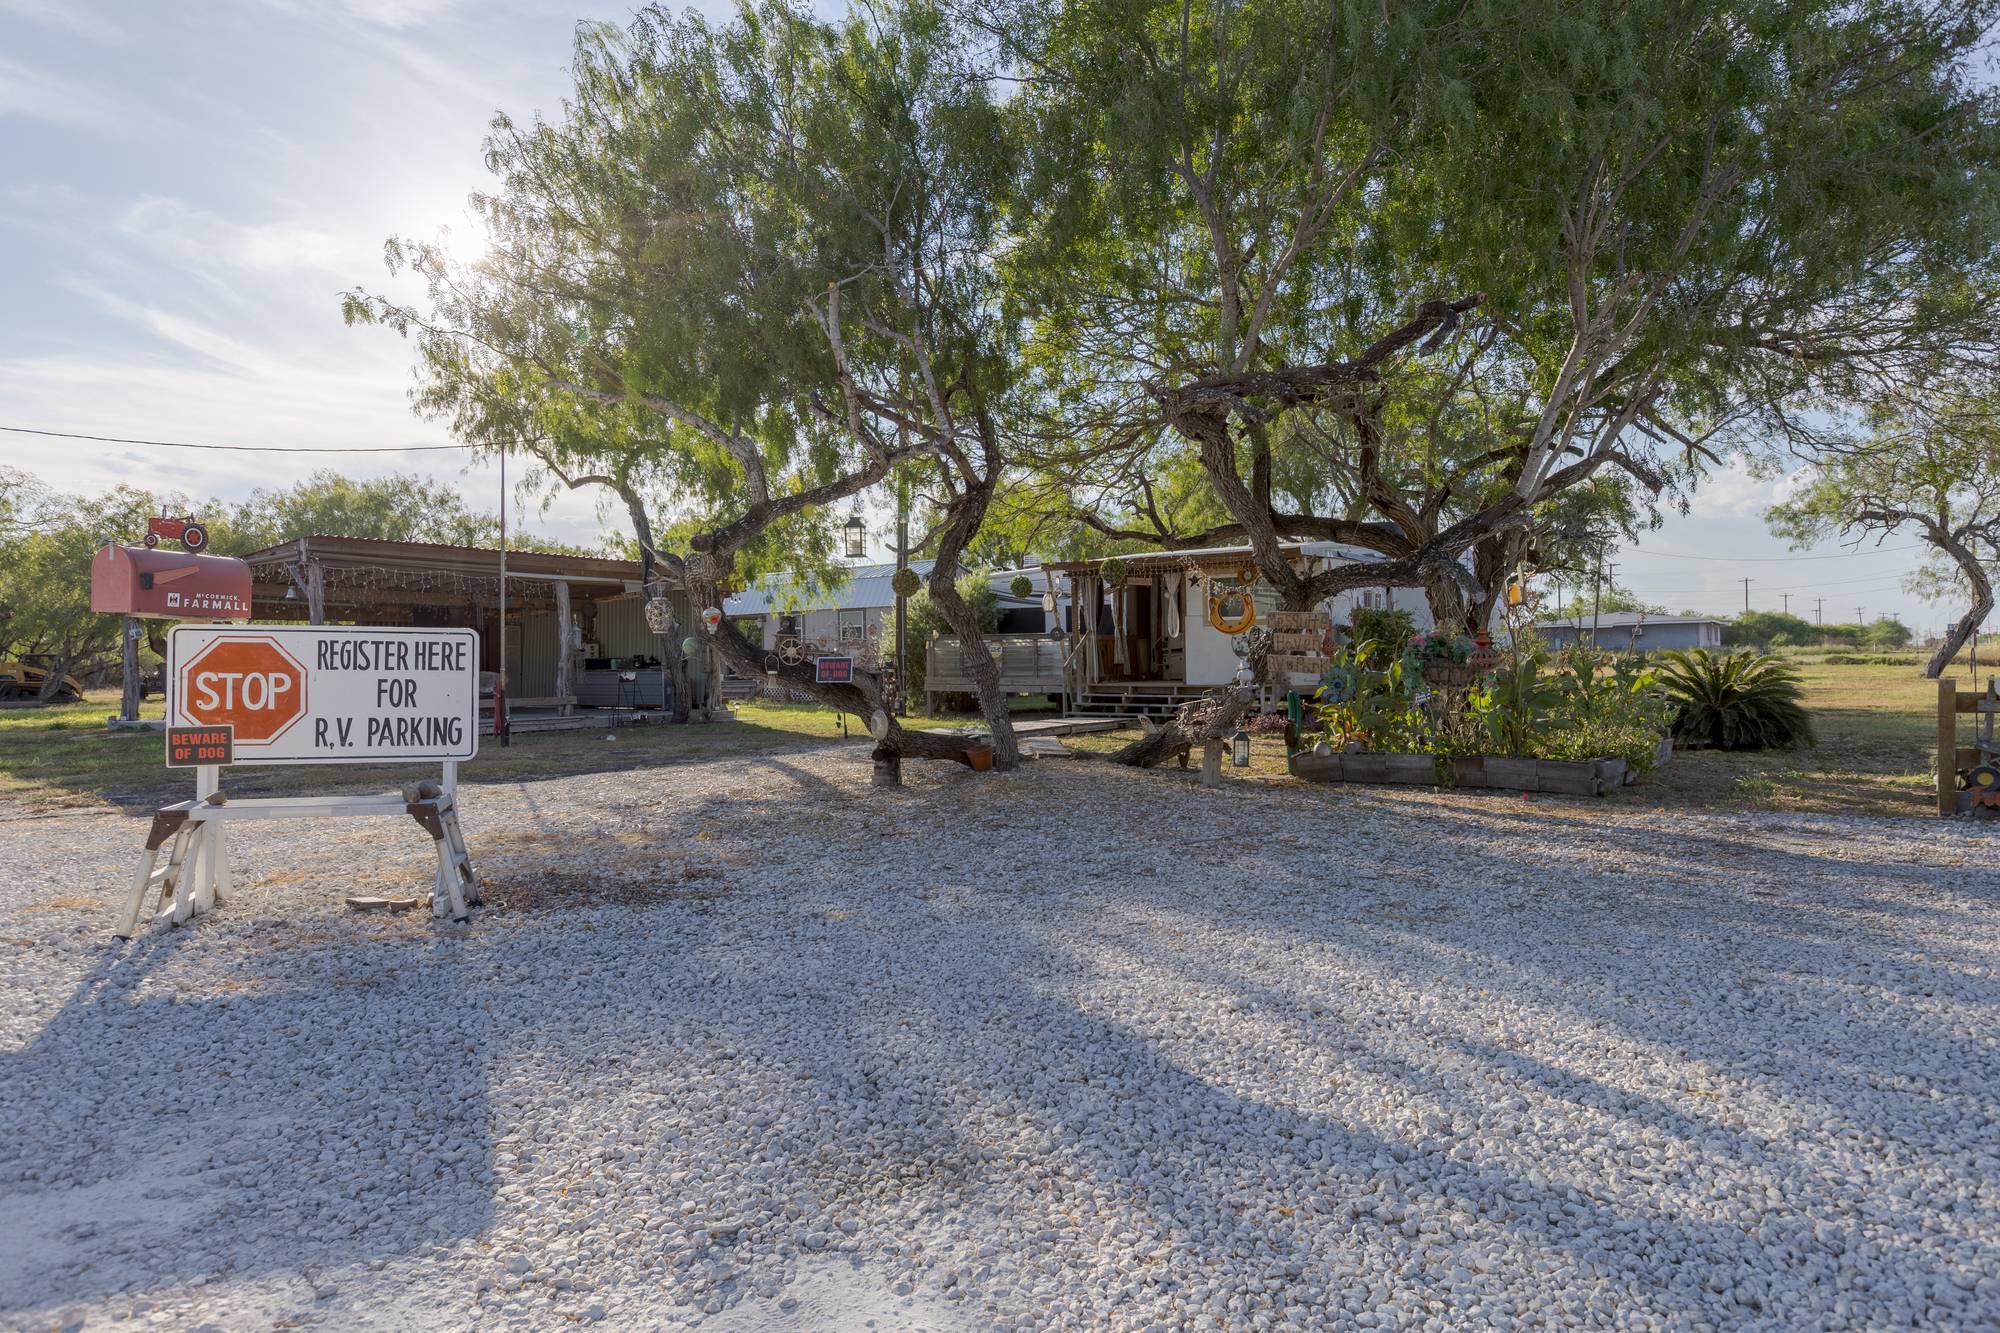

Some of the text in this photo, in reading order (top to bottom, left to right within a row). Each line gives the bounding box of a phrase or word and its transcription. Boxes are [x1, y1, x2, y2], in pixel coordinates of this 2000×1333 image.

[183, 598, 249, 611] FARMALL
[1276, 634, 1320, 650] Haven
[317, 639, 466, 671] REGISTER HERE
[1296, 656, 1329, 673] Park
[195, 671, 292, 711] STOP
[377, 678, 417, 708] FOR
[172, 732, 228, 745] BEWARE
[315, 716, 463, 749] R.V. PARKING
[175, 746, 225, 760] OF DOG
